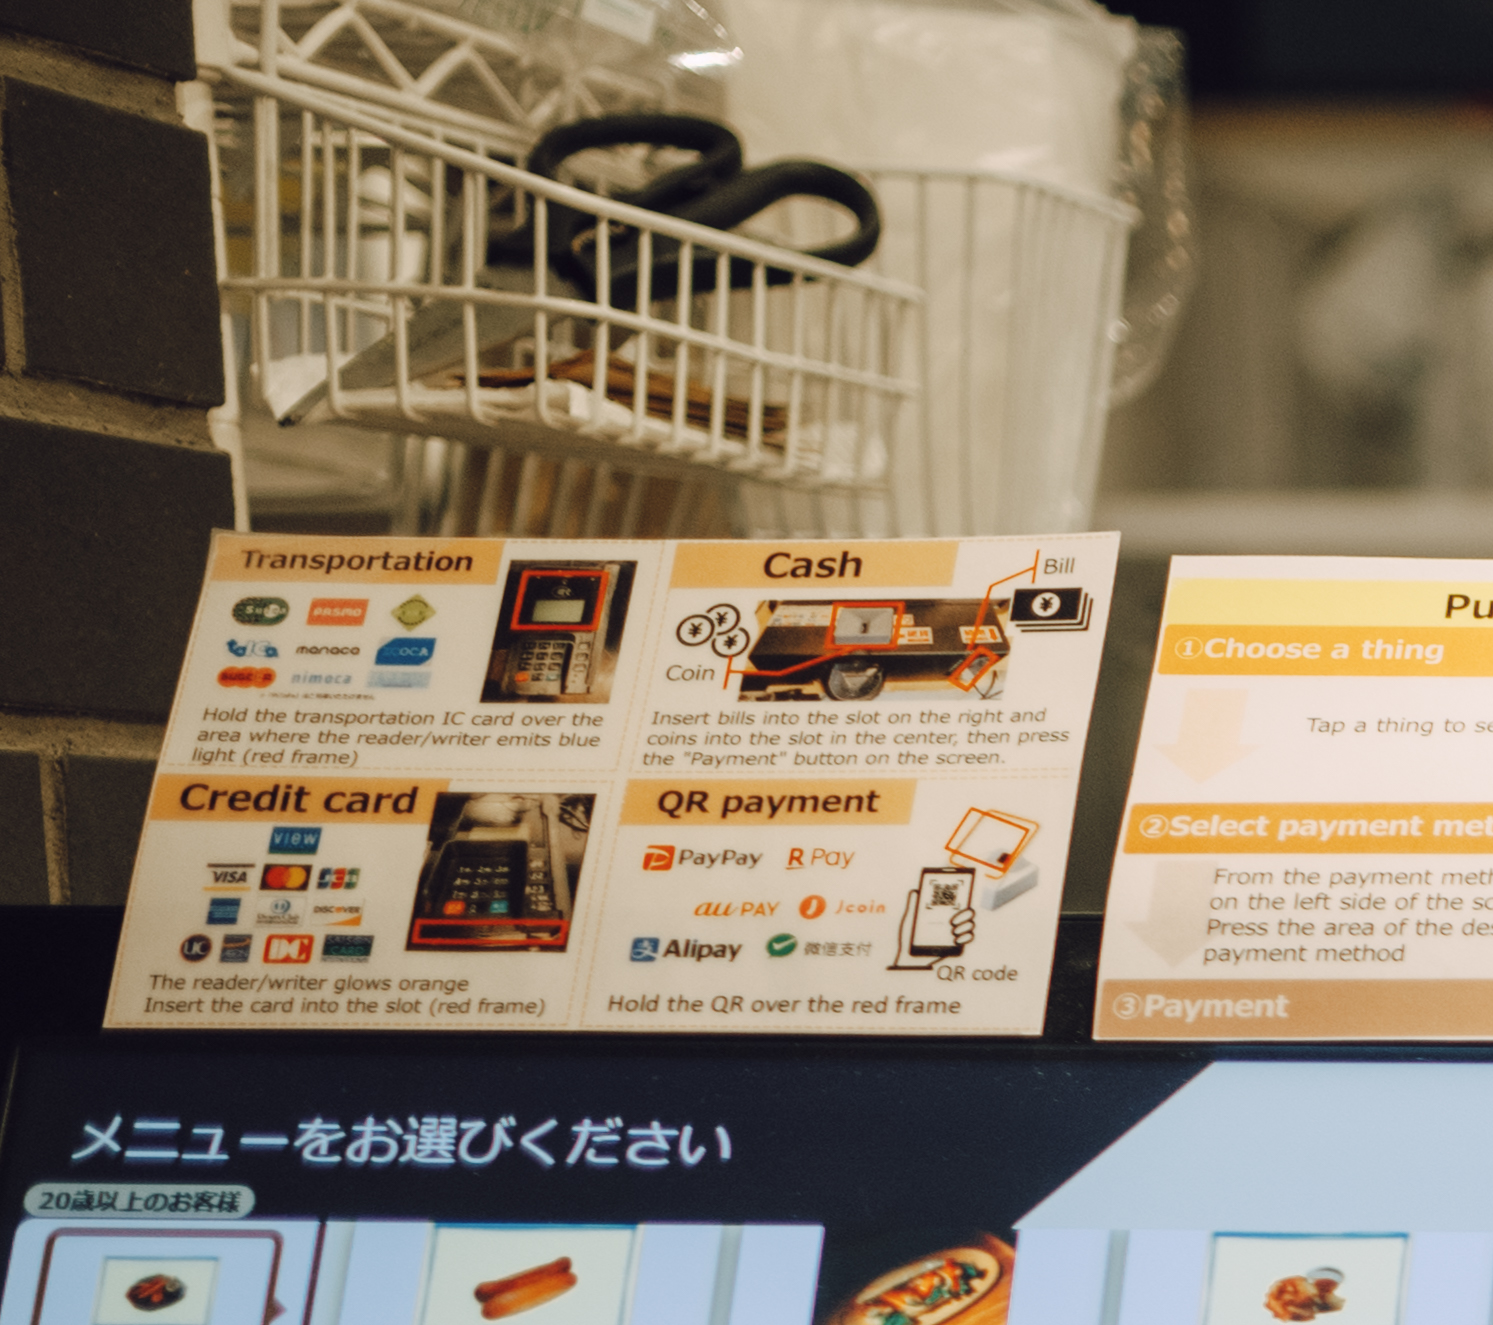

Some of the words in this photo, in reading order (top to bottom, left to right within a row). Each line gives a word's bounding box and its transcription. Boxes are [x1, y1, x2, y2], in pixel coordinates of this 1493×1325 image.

[243, 550, 475, 576] Transportation
[763, 549, 862, 580] Cash
[1043, 557, 1076, 576] Bill
[295, 645, 361, 657] manaca
[1331, 641, 1350, 661] a
[1361, 638, 1445, 666] thing
[665, 663, 716, 683] Coin
[202, 707, 249, 724] Hold
[254, 707, 289, 725] the
[293, 709, 436, 728] transportation
[442, 710, 465, 727] IC
[470, 711, 515, 728] card
[520, 714, 565, 728] over
[571, 712, 604, 728] the
[1307, 716, 1346, 737] Tap
[1353, 720, 1368, 735] a
[1376, 717, 1435, 738] thing
[1443, 718, 1466, 735] to
[196, 729, 242, 744] area
[249, 728, 311, 745] where
[317, 729, 351, 745] the
[356, 730, 490, 748] reader/writer
[496, 733, 551, 748] emits
[558, 732, 601, 748] blue
[191, 747, 236, 768] light
[242, 749, 285, 767] (red
[290, 749, 359, 769] frame)
[179, 782, 310, 814] Credit
[323, 785, 419, 815] card
[657, 789, 709, 820] QR
[721, 789, 879, 821] payment
[1277, 815, 1424, 845] payment
[677, 848, 761, 870] PayPay
[212, 870, 248, 883] VISA
[663, 939, 742, 963] Alipay
[149, 972, 187, 992] The
[192, 974, 328, 992] reader/writer
[333, 974, 392, 996] glows
[398, 978, 470, 997] orange
[936, 964, 967, 984] QR
[971, 965, 1021, 984] code
[607, 994, 660, 1014] Hold
[667, 994, 704, 1014] the
[710, 994, 744, 1015] QR
[750, 998, 801, 1015] over
[807, 995, 845, 1015] the
[851, 995, 889, 1015] red
[895, 994, 962, 1015] frame
[71, 1110, 732, 1171] メニューをお選びください
[39, 1187, 244, 1217] 20歳以上のお客様
